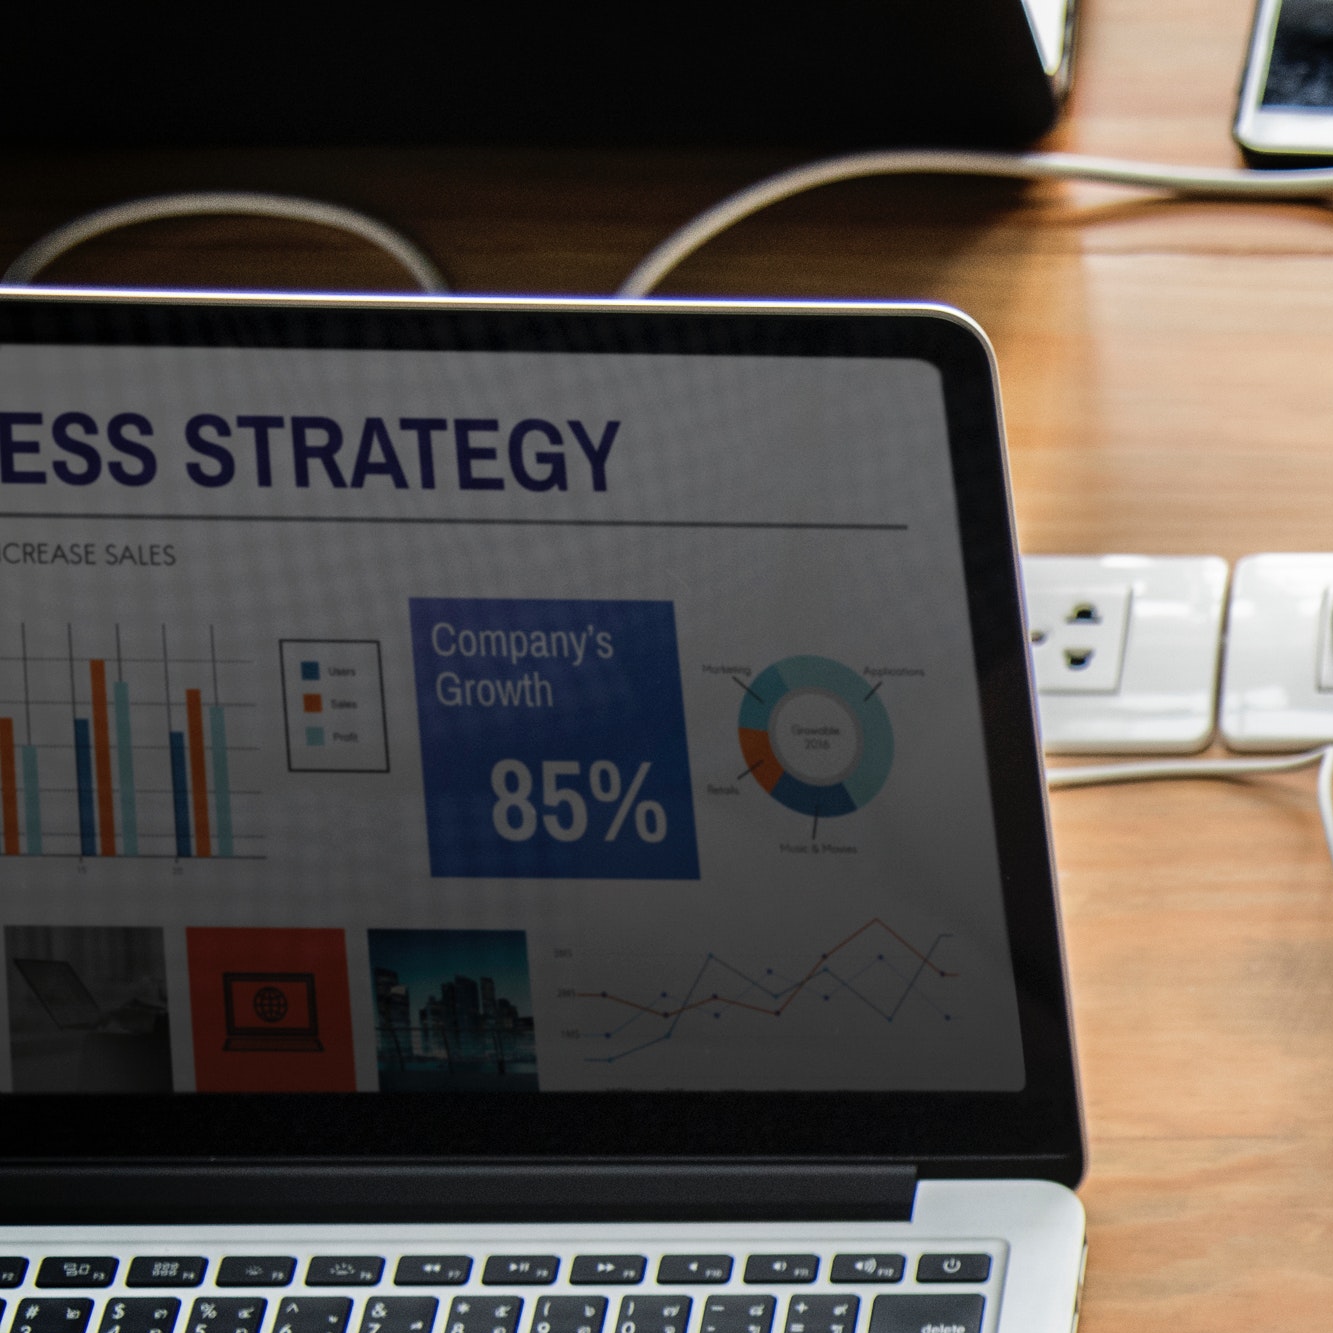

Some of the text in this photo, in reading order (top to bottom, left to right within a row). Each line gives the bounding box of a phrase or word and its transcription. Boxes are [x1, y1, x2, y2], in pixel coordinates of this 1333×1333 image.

[0, 411, 622, 492] ESS STRATEGY
[0, 542, 177, 567] CREASE SALES
[432, 622, 615, 667] Company's
[435, 671, 554, 708] Growth
[490, 757, 669, 844] 85%
